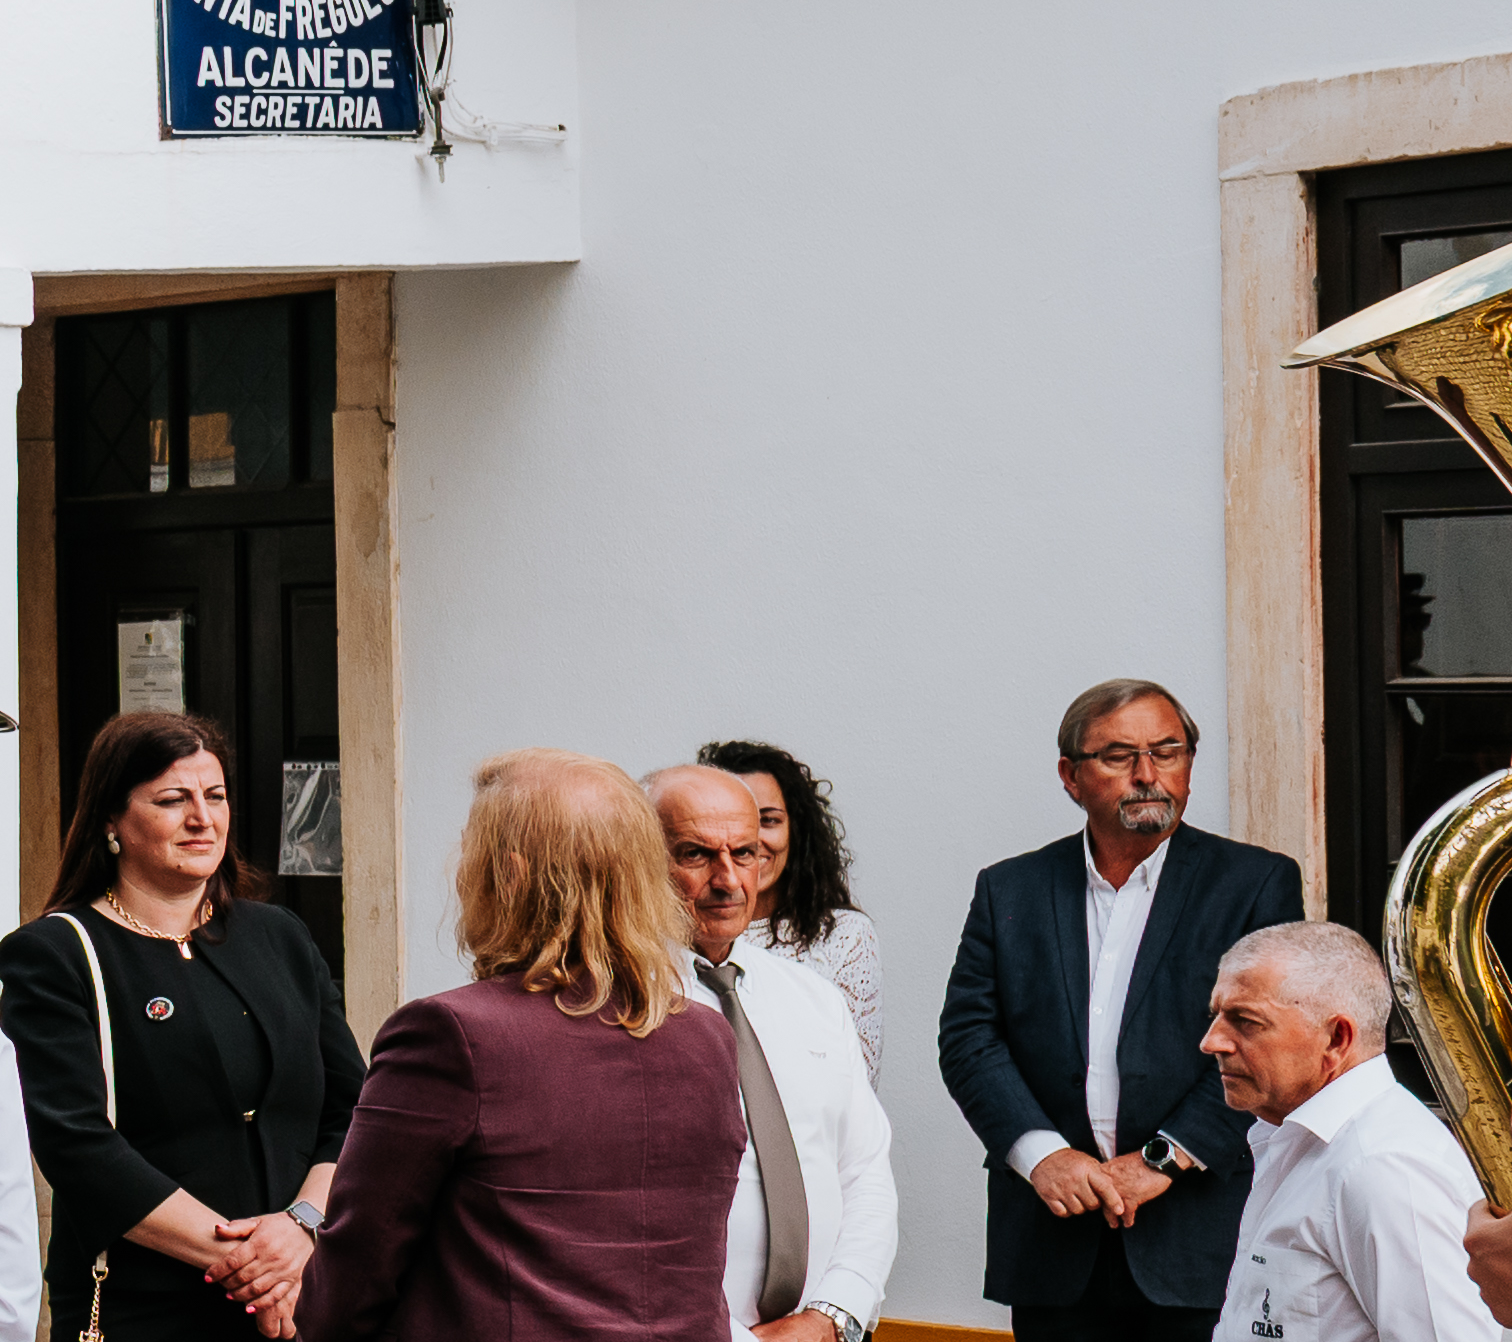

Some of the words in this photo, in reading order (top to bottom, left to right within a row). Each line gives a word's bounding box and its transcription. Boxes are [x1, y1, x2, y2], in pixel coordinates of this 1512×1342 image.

[252, 9, 277, 38] DE
[197, 40, 395, 89] ALCANÊDE
[214, 95, 383, 129] SECRETARIA
